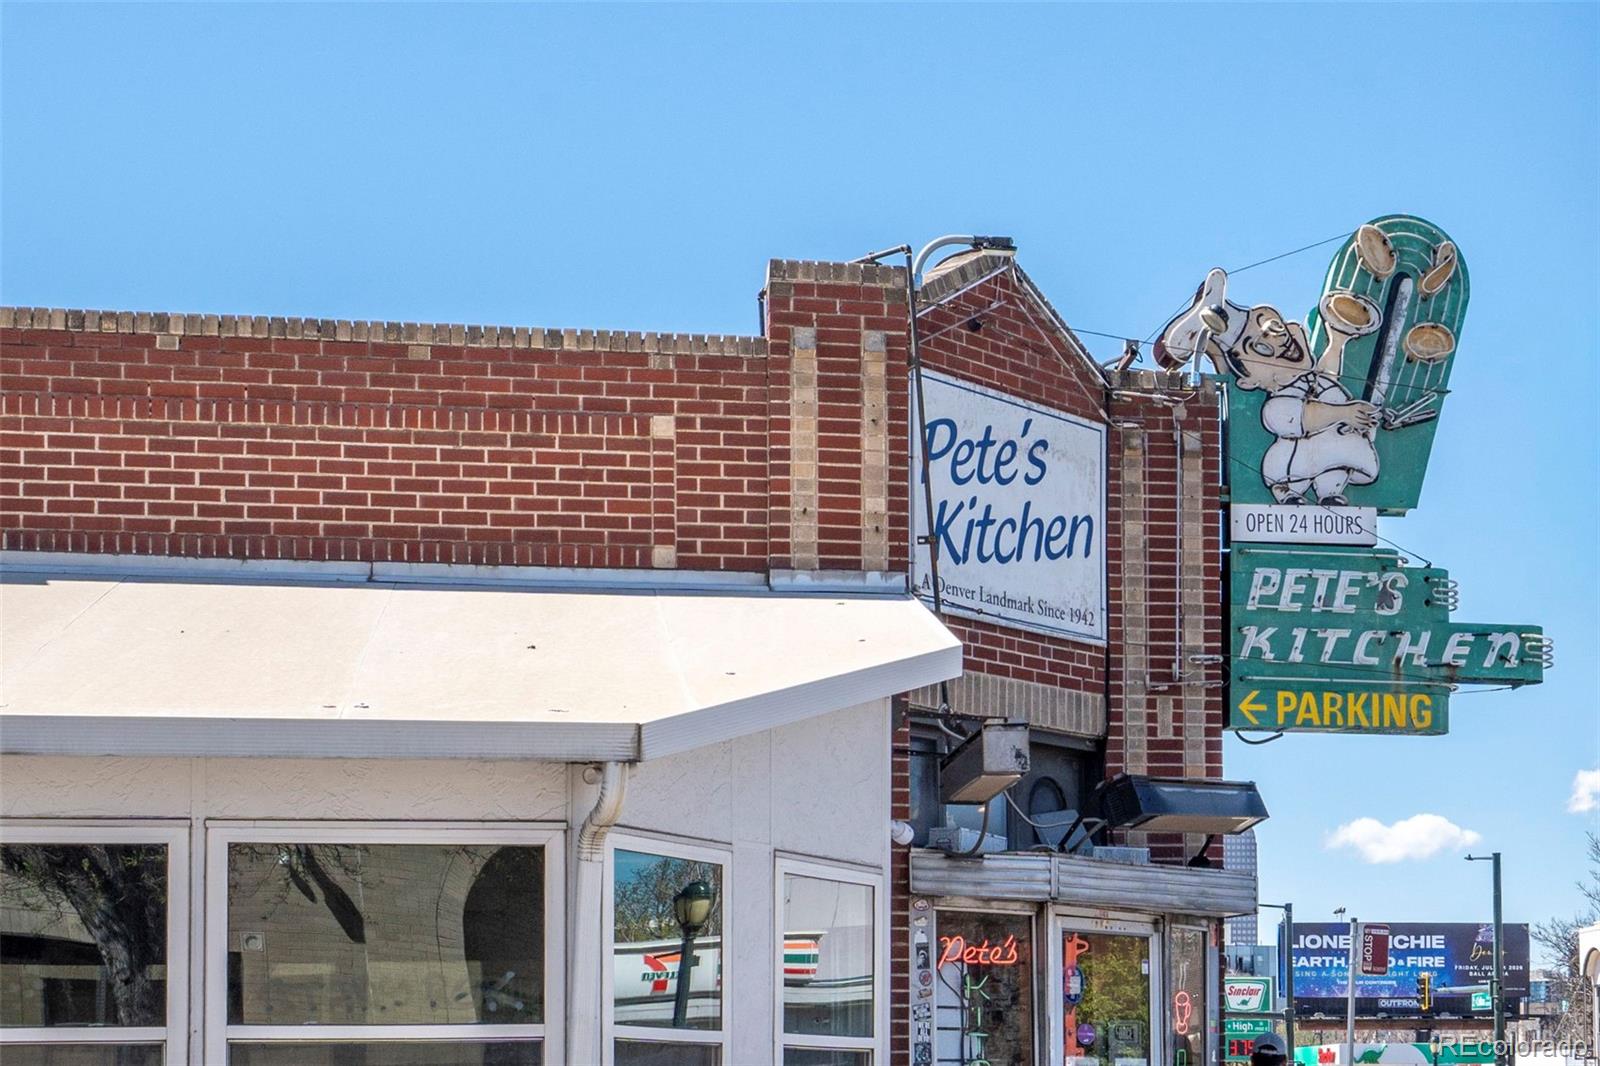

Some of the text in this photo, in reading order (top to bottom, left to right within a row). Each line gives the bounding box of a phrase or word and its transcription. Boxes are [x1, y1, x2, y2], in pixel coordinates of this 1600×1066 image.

[921, 417, 1049, 486] Pete's
[936, 495, 1093, 566] Kitchen
[1246, 513, 1364, 535] OPEN 24 HOURS
[922, 573, 1095, 627] A Denver Landmark Since 1942
[1246, 567, 1408, 615] PETE'S
[1276, 691, 1432, 730] PARKING
[938, 934, 1018, 970] Pete's
[1292, 934, 1445, 949] IONE ICHIE
[1363, 935, 1373, 962] STOP
[1407, 956, 1445, 967] FIRE
[1228, 985, 1261, 996] Sinclair
[1232, 1022, 1253, 1032] High
